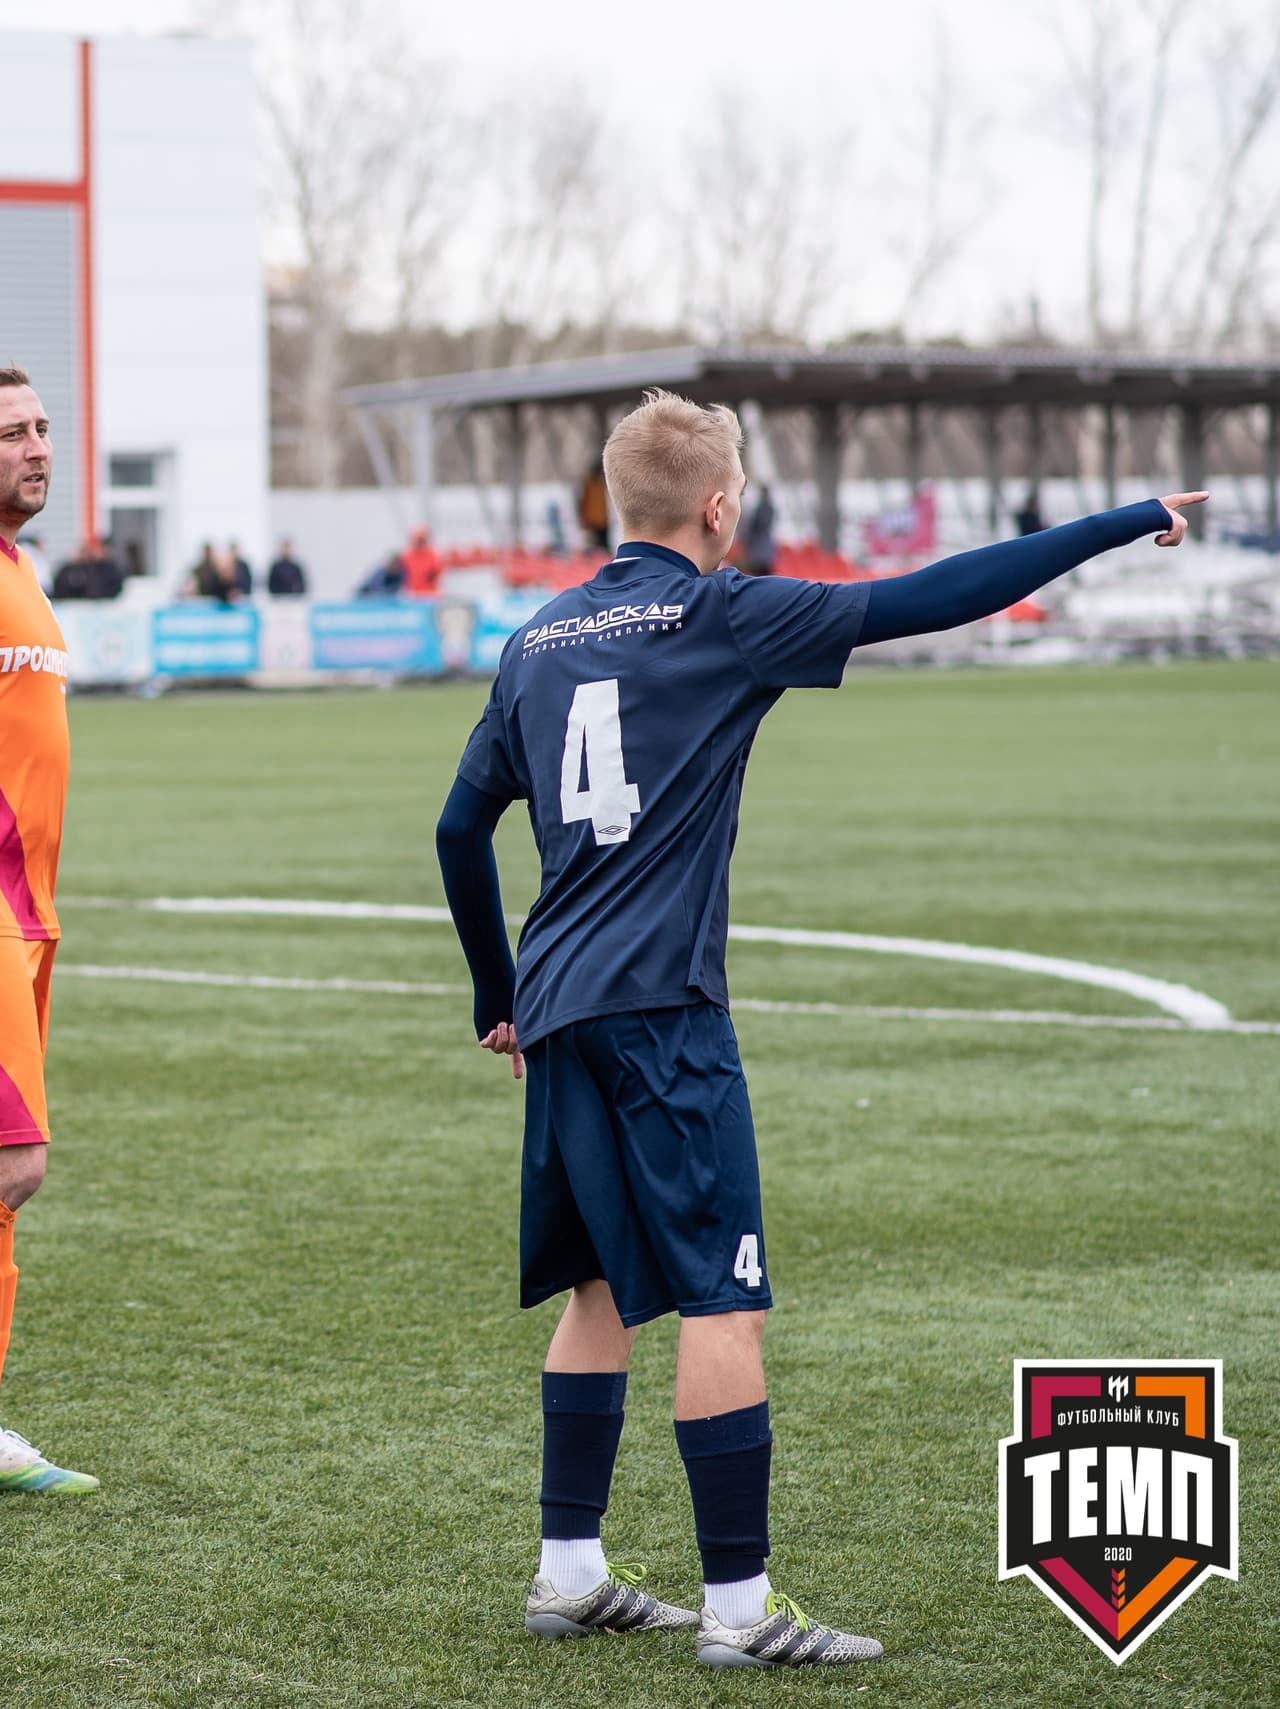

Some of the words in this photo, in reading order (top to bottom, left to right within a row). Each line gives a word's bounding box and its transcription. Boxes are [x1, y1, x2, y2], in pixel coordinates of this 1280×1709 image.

[522, 636, 585, 660] УГОЛЬНАЯ
[597, 622, 682, 642] КОМПАНИЯ
[523, 602, 683, 649] РАСПАДСКАЯ
[560, 678, 641, 846] 4
[734, 1234, 762, 1287] 4
